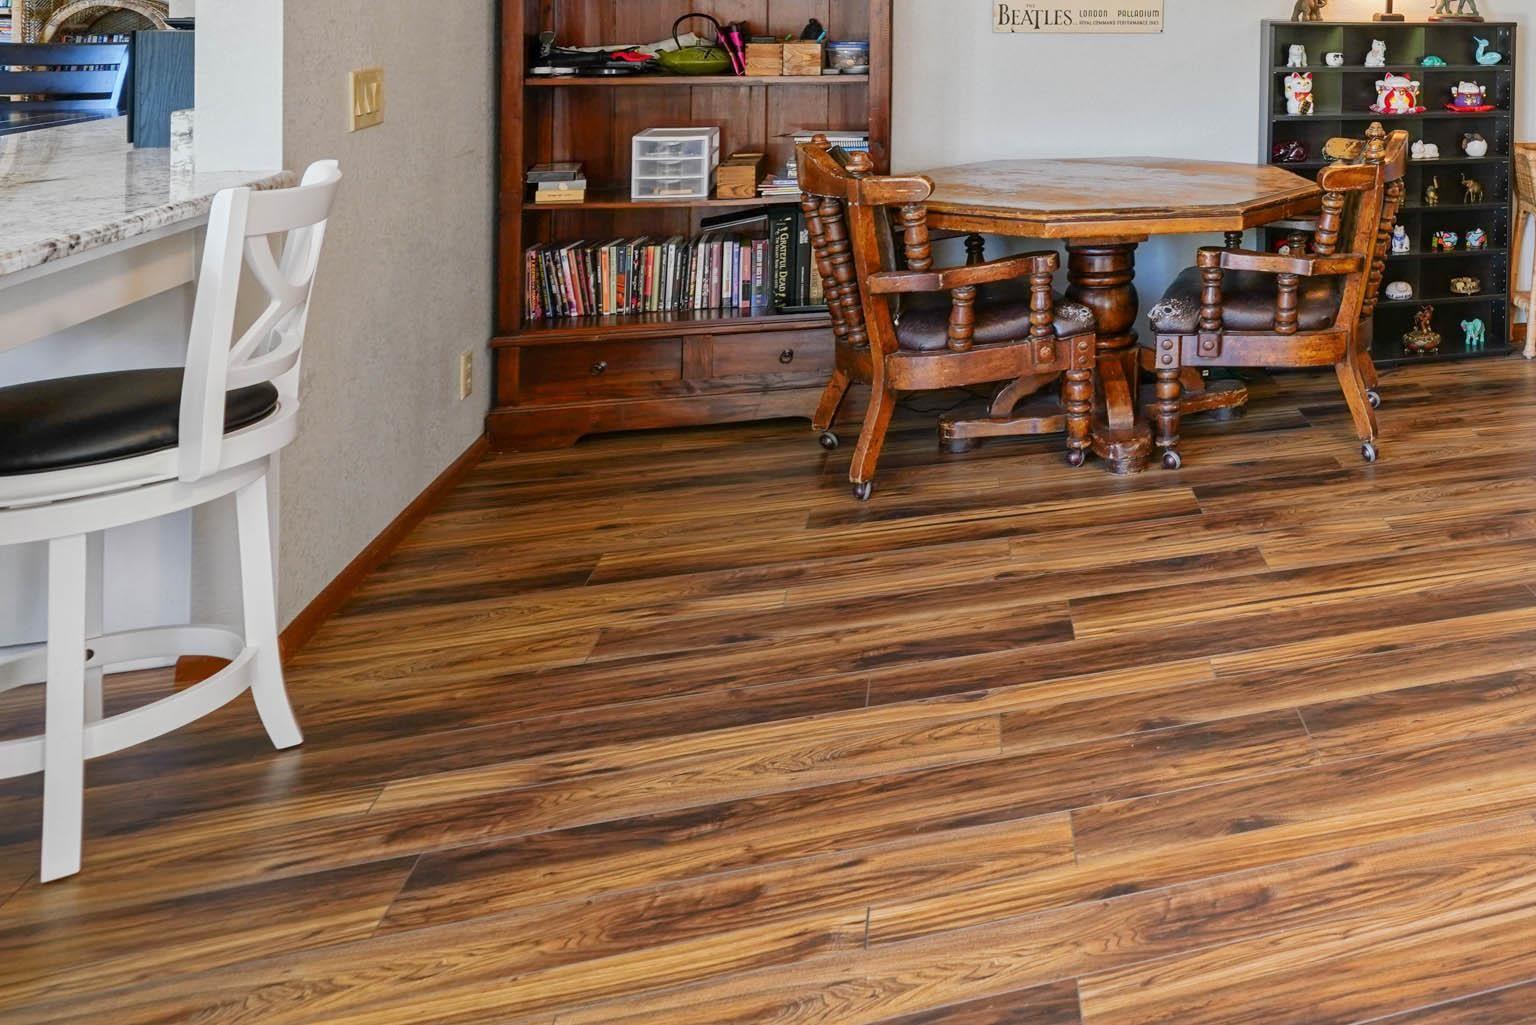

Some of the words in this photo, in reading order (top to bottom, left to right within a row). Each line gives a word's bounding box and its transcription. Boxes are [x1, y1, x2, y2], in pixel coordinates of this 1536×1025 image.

[998, 4, 1073, 29] BEATLES
[1079, 9, 1108, 17] LONDON
[1117, 9, 1160, 17] PALLADIUM
[780, 232, 789, 271] GRATEFUL
[778, 271, 788, 293] DEAD
